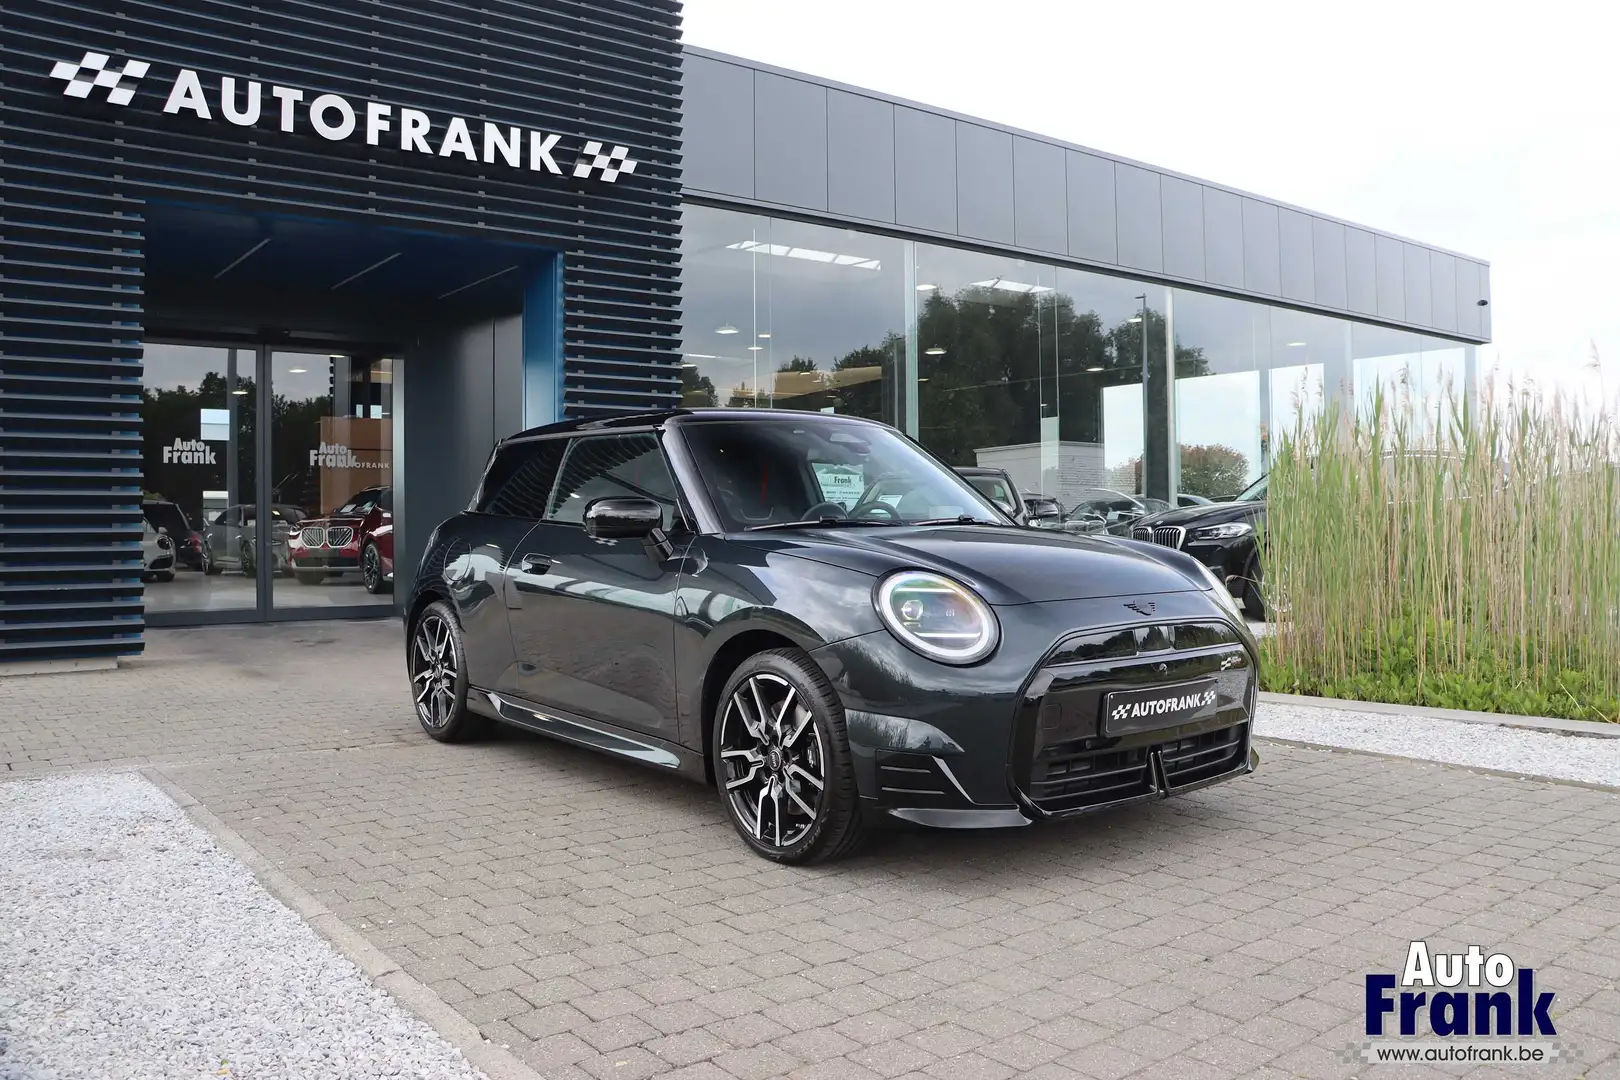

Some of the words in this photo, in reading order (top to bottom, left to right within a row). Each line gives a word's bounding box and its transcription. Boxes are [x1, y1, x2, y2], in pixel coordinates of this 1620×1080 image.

[163, 68, 563, 175] AUTOFRANK
[173, 437, 205, 452] Auto
[319, 441, 347, 454] Auto
[163, 445, 217, 465] Frank
[1131, 693, 1202, 718] AUTOFRANK
